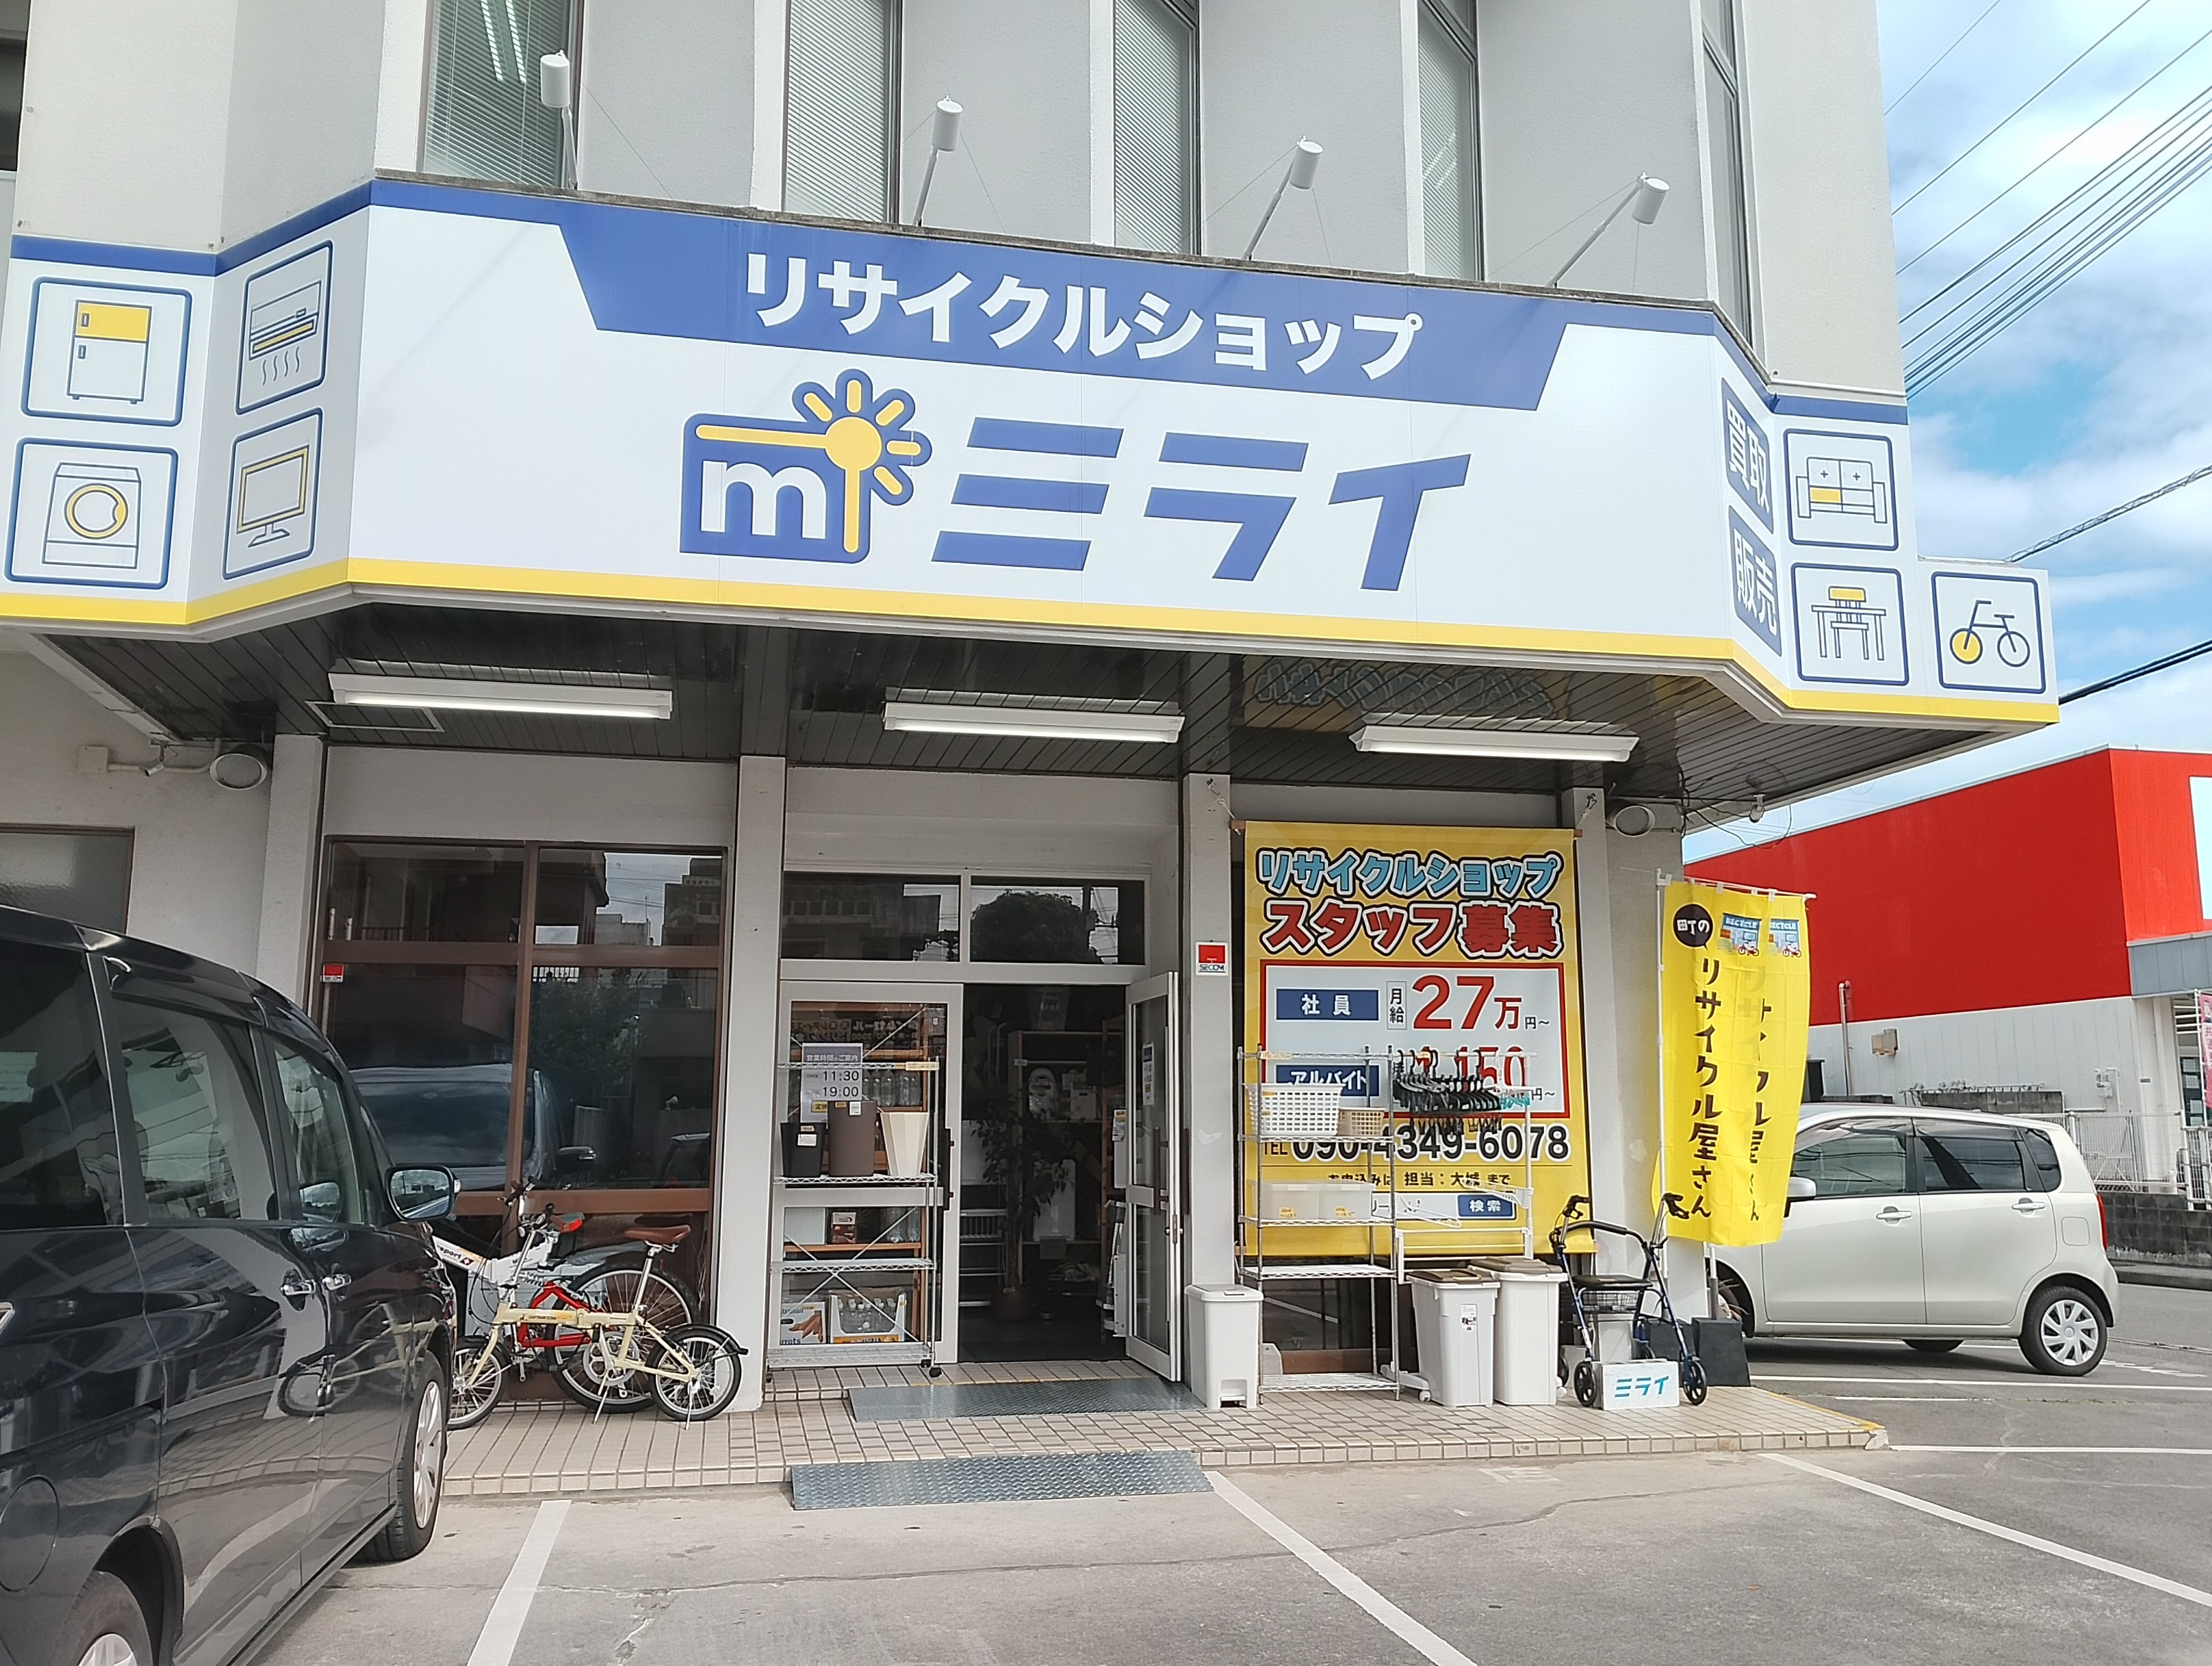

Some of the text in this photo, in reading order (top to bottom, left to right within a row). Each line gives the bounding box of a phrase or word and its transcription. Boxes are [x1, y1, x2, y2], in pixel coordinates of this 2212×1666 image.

[747, 253, 1423, 381] リサイクルショップ
[1726, 399, 1771, 514] 買取
[930, 415, 1471, 592] ミライ
[1733, 527, 1777, 637] 販売
[1258, 849, 1562, 897] リサイクルショップ
[1262, 899, 1561, 957] スタッフ募集
[1676, 919, 1710, 936] 町の
[1725, 917, 1758, 928] RECYCLE
[1301, 994, 1352, 1017] 社員
[1388, 988, 1405, 1025] 月給
[822, 1070, 859, 1081] 11:30
[1290, 1069, 1366, 1090] アルバイト
[1688, 957, 1722, 1218] リサイクル屋さん
[822, 1086, 859, 1097] 19:00
[1469, 1200, 1502, 1213] 検索
[1613, 1374, 1670, 1399] ミライ
